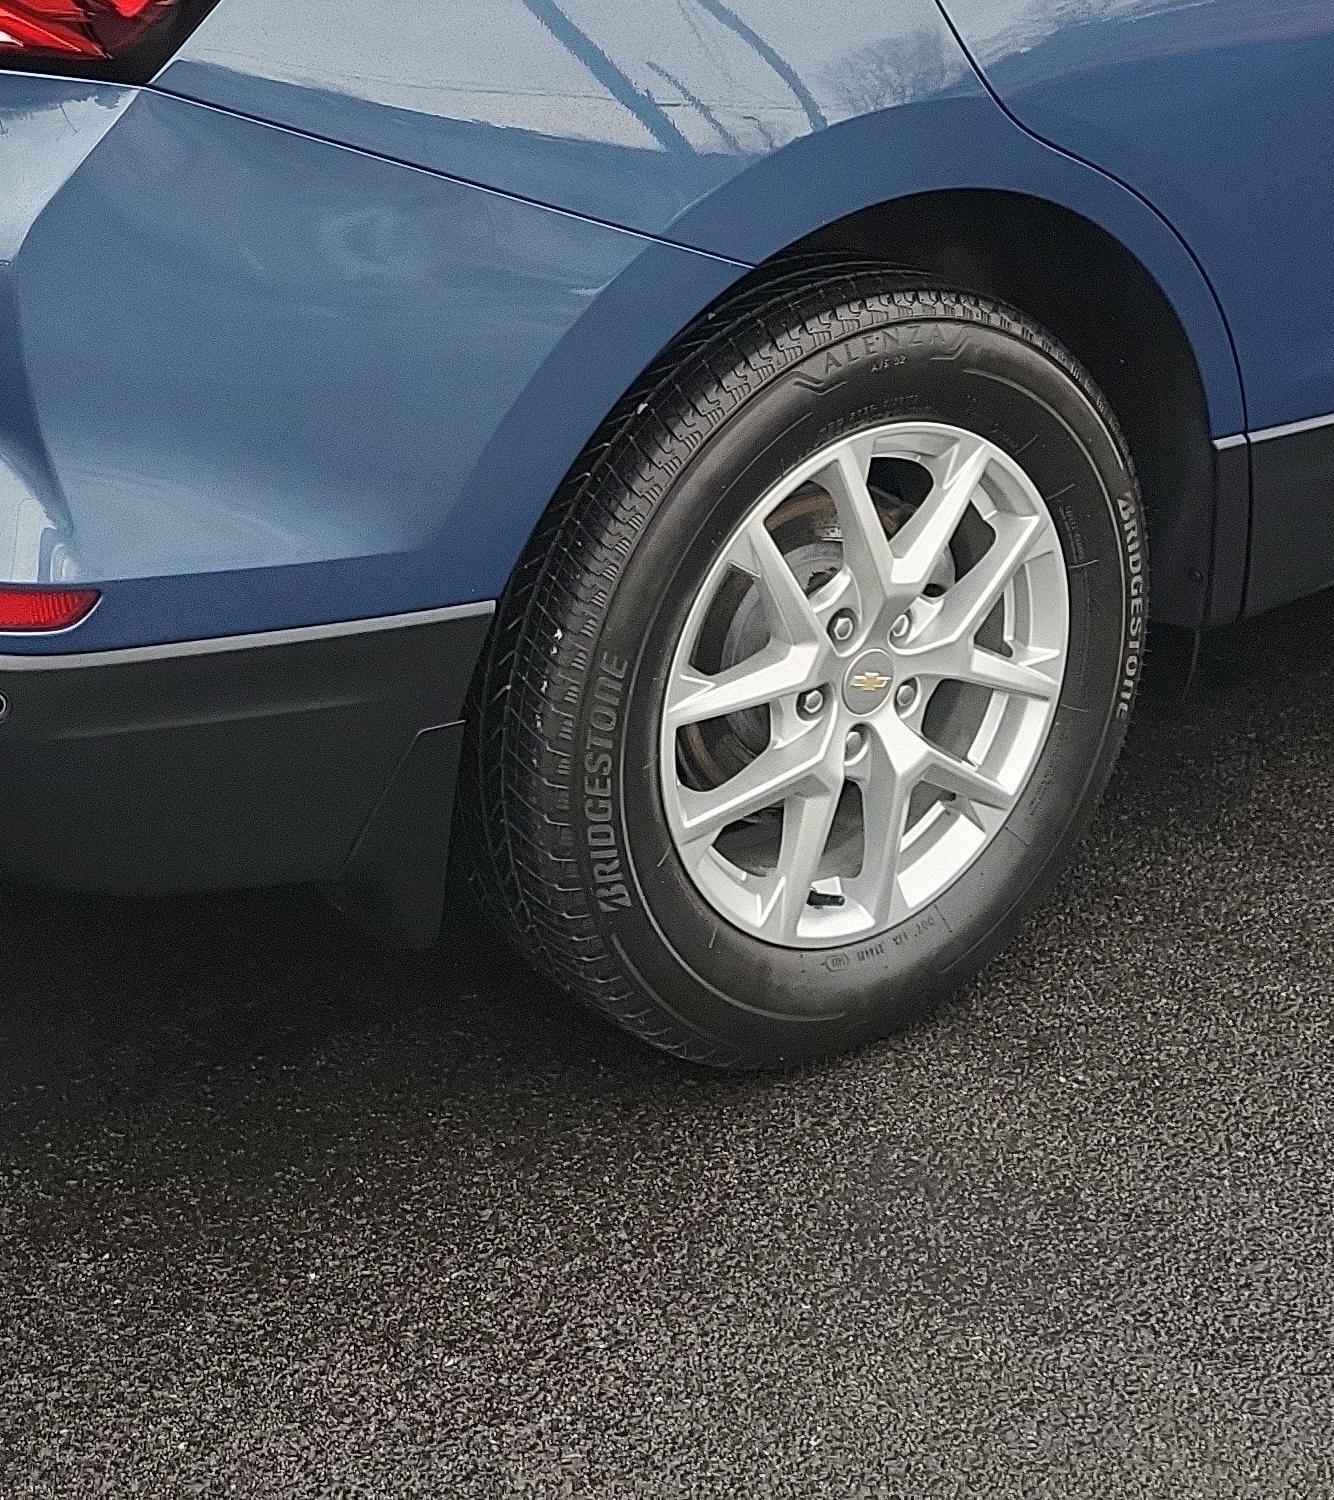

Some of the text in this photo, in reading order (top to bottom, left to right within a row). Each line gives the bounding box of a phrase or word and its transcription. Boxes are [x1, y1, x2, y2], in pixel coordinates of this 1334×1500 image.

[824, 323, 948, 376] ALENZA
[1116, 490, 1144, 720] BRIDGESTONE
[584, 650, 633, 914] BRIDGESTONE
